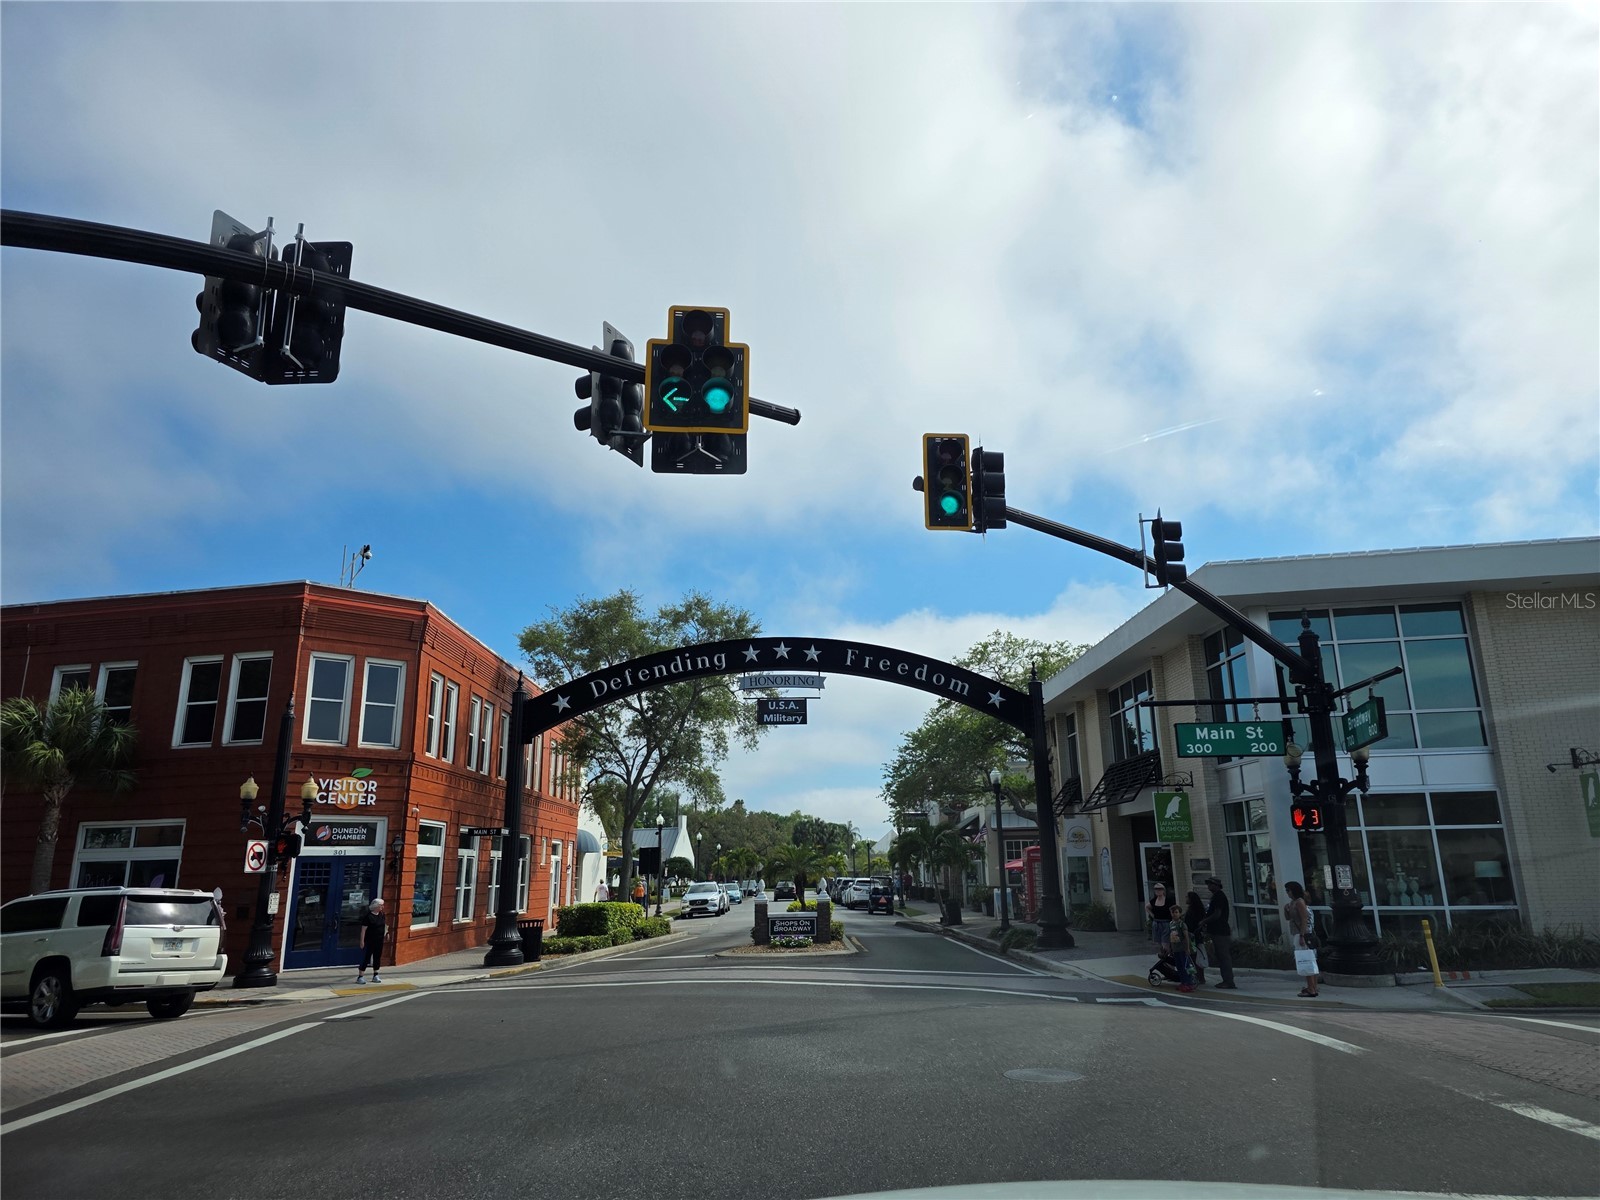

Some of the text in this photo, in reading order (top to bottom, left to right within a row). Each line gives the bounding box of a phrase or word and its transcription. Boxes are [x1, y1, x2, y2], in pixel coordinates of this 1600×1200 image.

[588, 648, 970, 699] Defending Freedom
[749, 675, 815, 687] HONORING
[768, 700, 800, 710] U.S.A.
[763, 713, 803, 723] Military
[1195, 726, 1264, 740] Main St
[1186, 742, 1278, 754] 300 200
[318, 778, 378, 792] VISITOR
[315, 791, 377, 806] CENTER
[1310, 809, 1319, 825] 3
